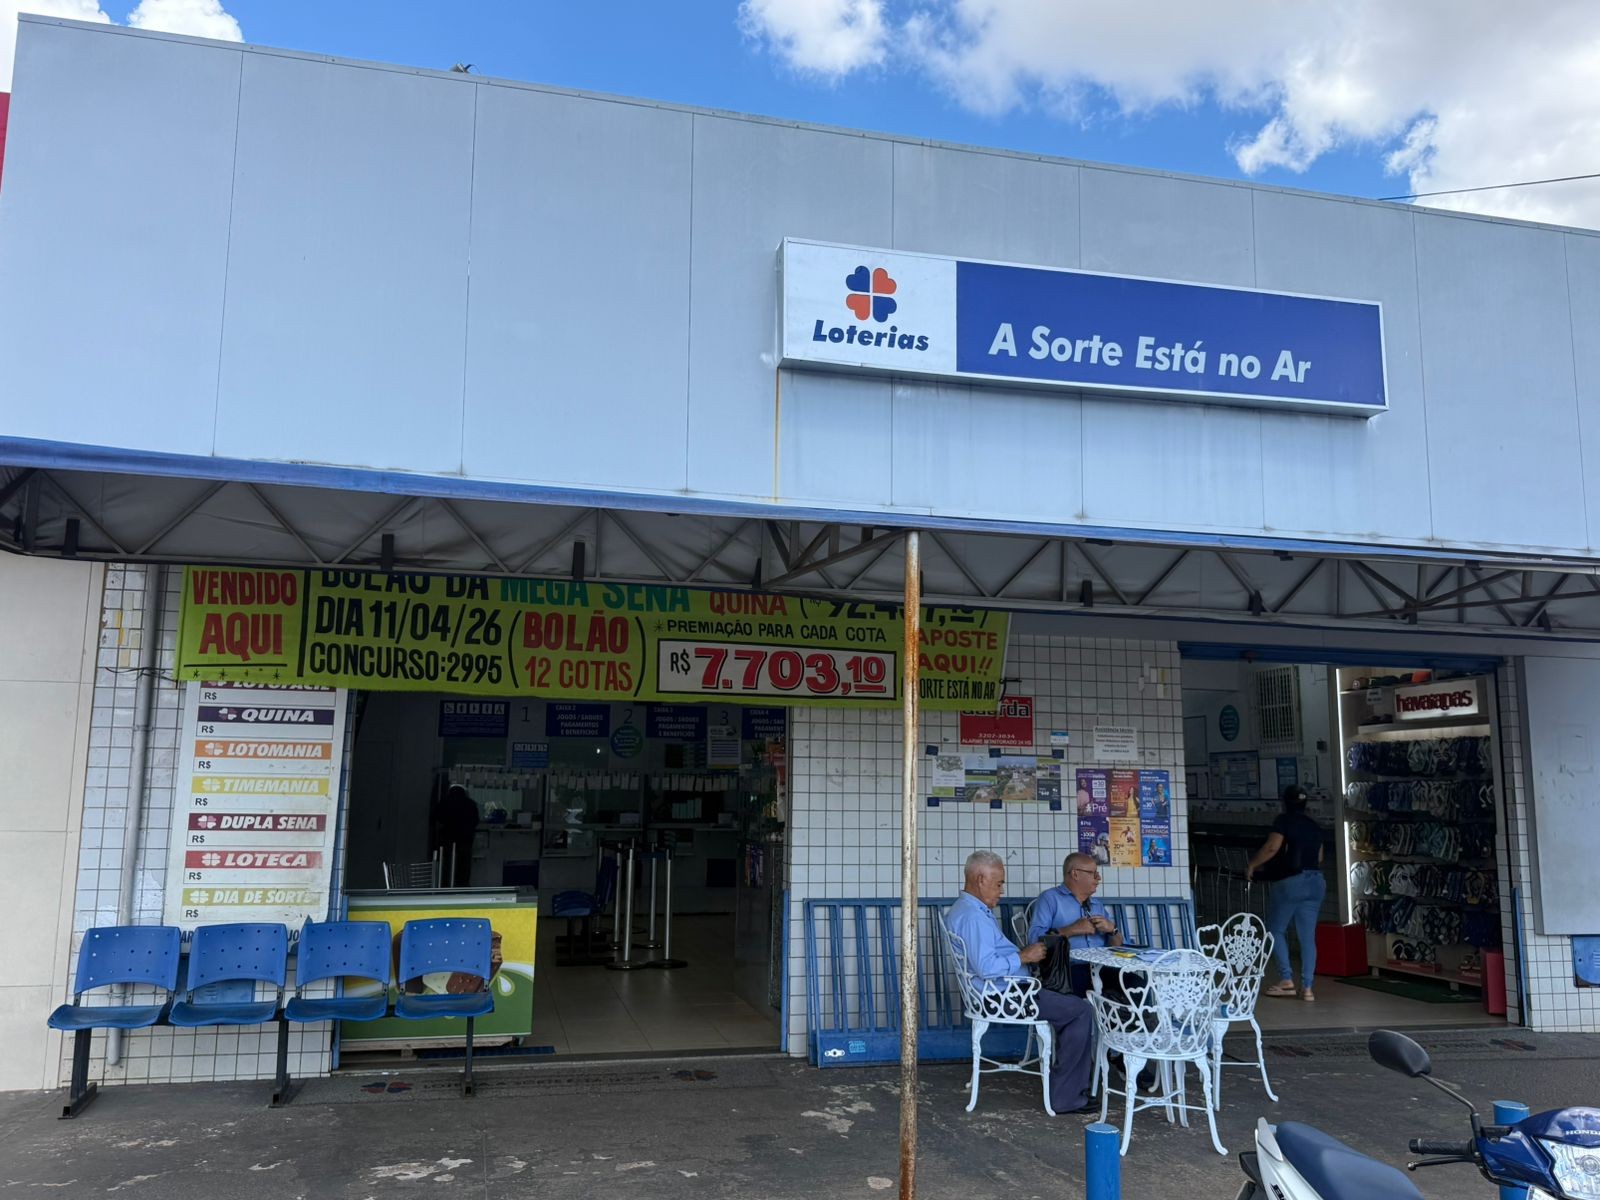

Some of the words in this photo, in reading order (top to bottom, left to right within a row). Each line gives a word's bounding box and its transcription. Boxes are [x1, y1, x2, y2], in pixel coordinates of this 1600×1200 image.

[812, 319, 930, 351] Loterias
[988, 322, 1018, 357] A
[1028, 325, 1123, 367] Sorte
[1135, 335, 1207, 374] Está
[1217, 353, 1261, 380] no
[1270, 350, 1312, 384] Ar
[192, 570, 298, 606] VENDIDO
[500, 579, 589, 608] MEGA
[602, 583, 690, 613] SENA
[709, 591, 788, 617] QUINA
[315, 596, 364, 637] DIA
[369, 598, 501, 648] 11/04/26
[198, 612, 283, 662] AQUI
[523, 610, 629, 654] BOLÃO
[667, 620, 752, 638] PREMIAÇÃO
[758, 623, 794, 639] PARA
[801, 624, 838, 641] CADA
[846, 626, 887, 643] COTA
[918, 628, 998, 650] APOSTE
[309, 642, 502, 684] CONCURSO:2995
[670, 648, 691, 675] R$
[694, 647, 887, 695] 7.703,10
[525, 655, 550, 688] 12
[559, 659, 633, 692] COTAS
[204, 692, 217, 700] R$
[947, 676, 970, 700] ESTÁ
[971, 680, 984, 700] NO
[984, 681, 996, 700] AR
[1395, 690, 1473, 713] havaianas
[241, 708, 315, 722] QUINA
[520, 706, 531, 722] 1
[623, 708, 633, 724] 2
[719, 710, 729, 726] 3
[201, 725, 214, 734] R$
[227, 743, 323, 758] LOTOMANIA
[198, 761, 211, 769] R$
[223, 779, 319, 793] TIMEMANIA
[195, 798, 208, 806] R$
[1092, 803, 1108, 813] Pré
[220, 815, 273, 830] DUPLA
[277, 816, 317, 830] SENA
[192, 835, 205, 843] R$
[224, 853, 308, 867] LOTECA
[189, 872, 202, 880] R$
[213, 892, 239, 904] DIA
[243, 892, 262, 904] DE
[186, 909, 199, 918] R$
